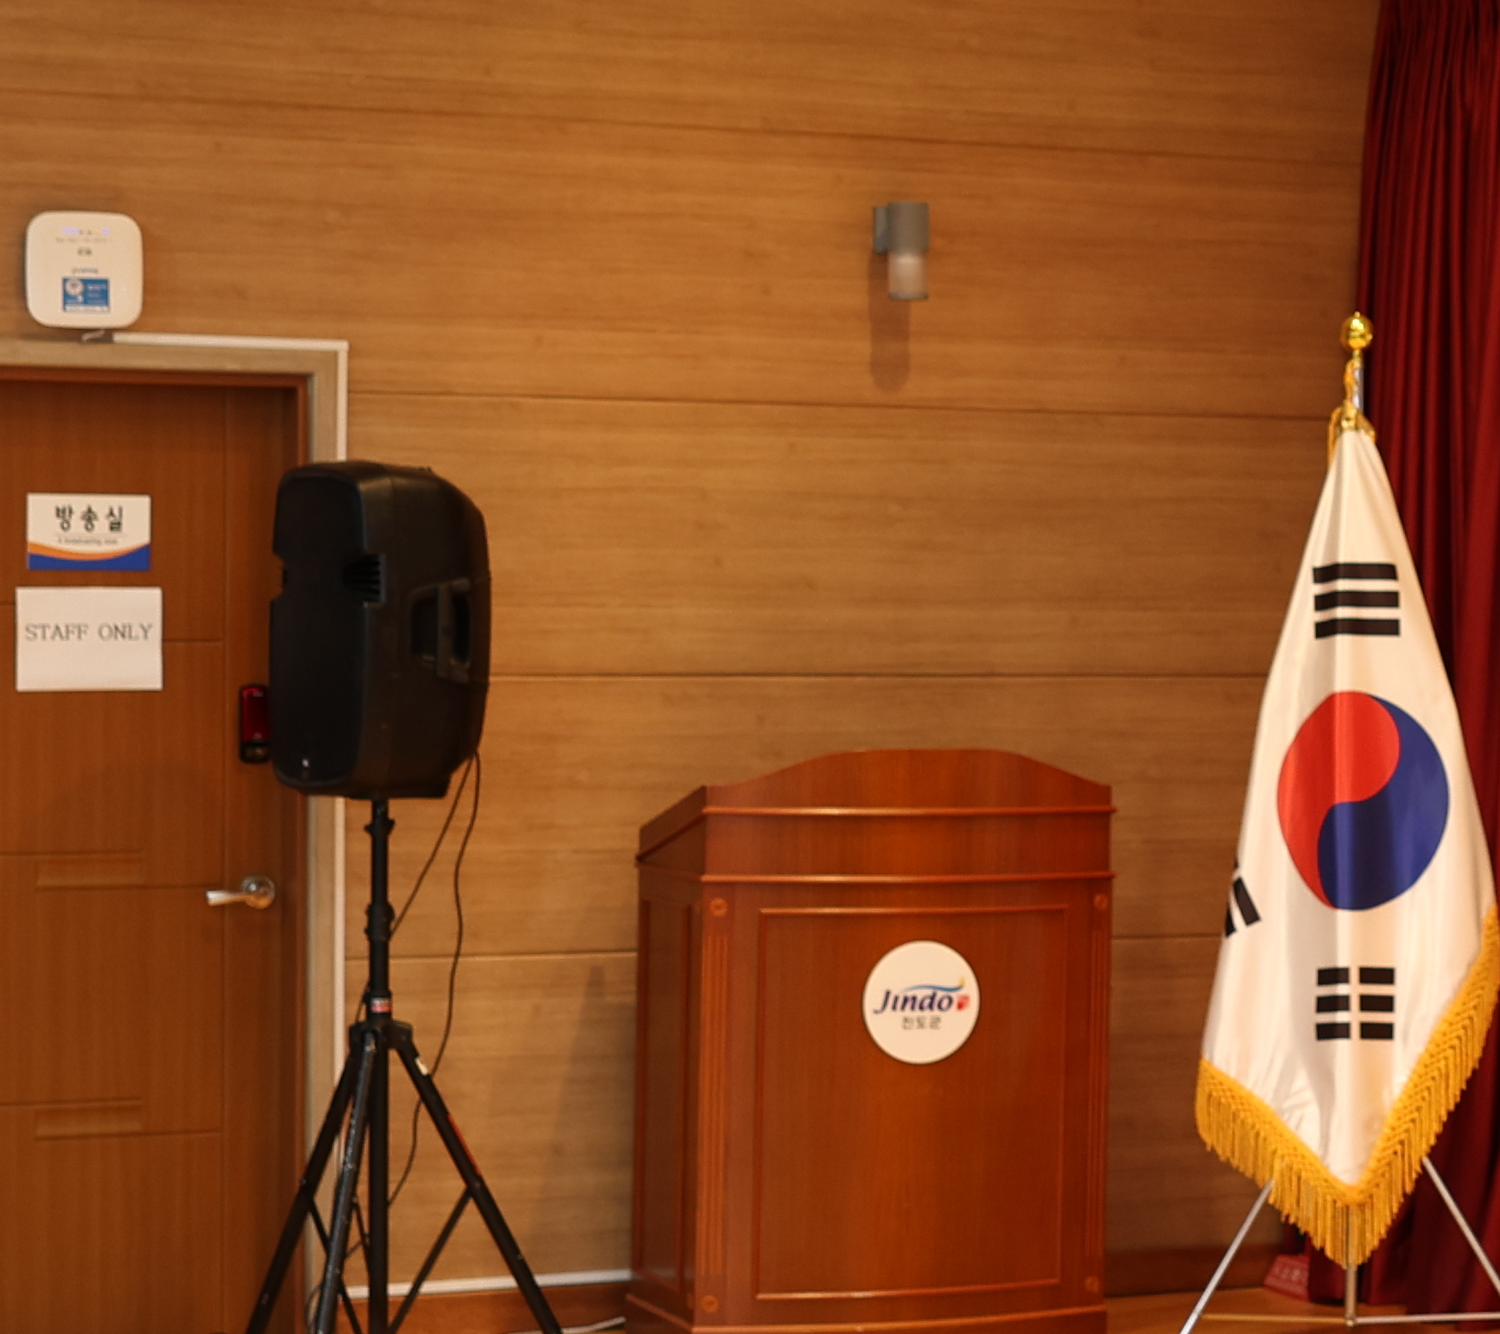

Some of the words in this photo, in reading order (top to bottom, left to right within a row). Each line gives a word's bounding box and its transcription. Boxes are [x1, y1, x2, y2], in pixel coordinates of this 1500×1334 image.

[55, 505, 123, 532] 방송실
[25, 622, 89, 642] STAFF
[97, 622, 152, 642] ONLY
[873, 989, 953, 1014] Jindo
